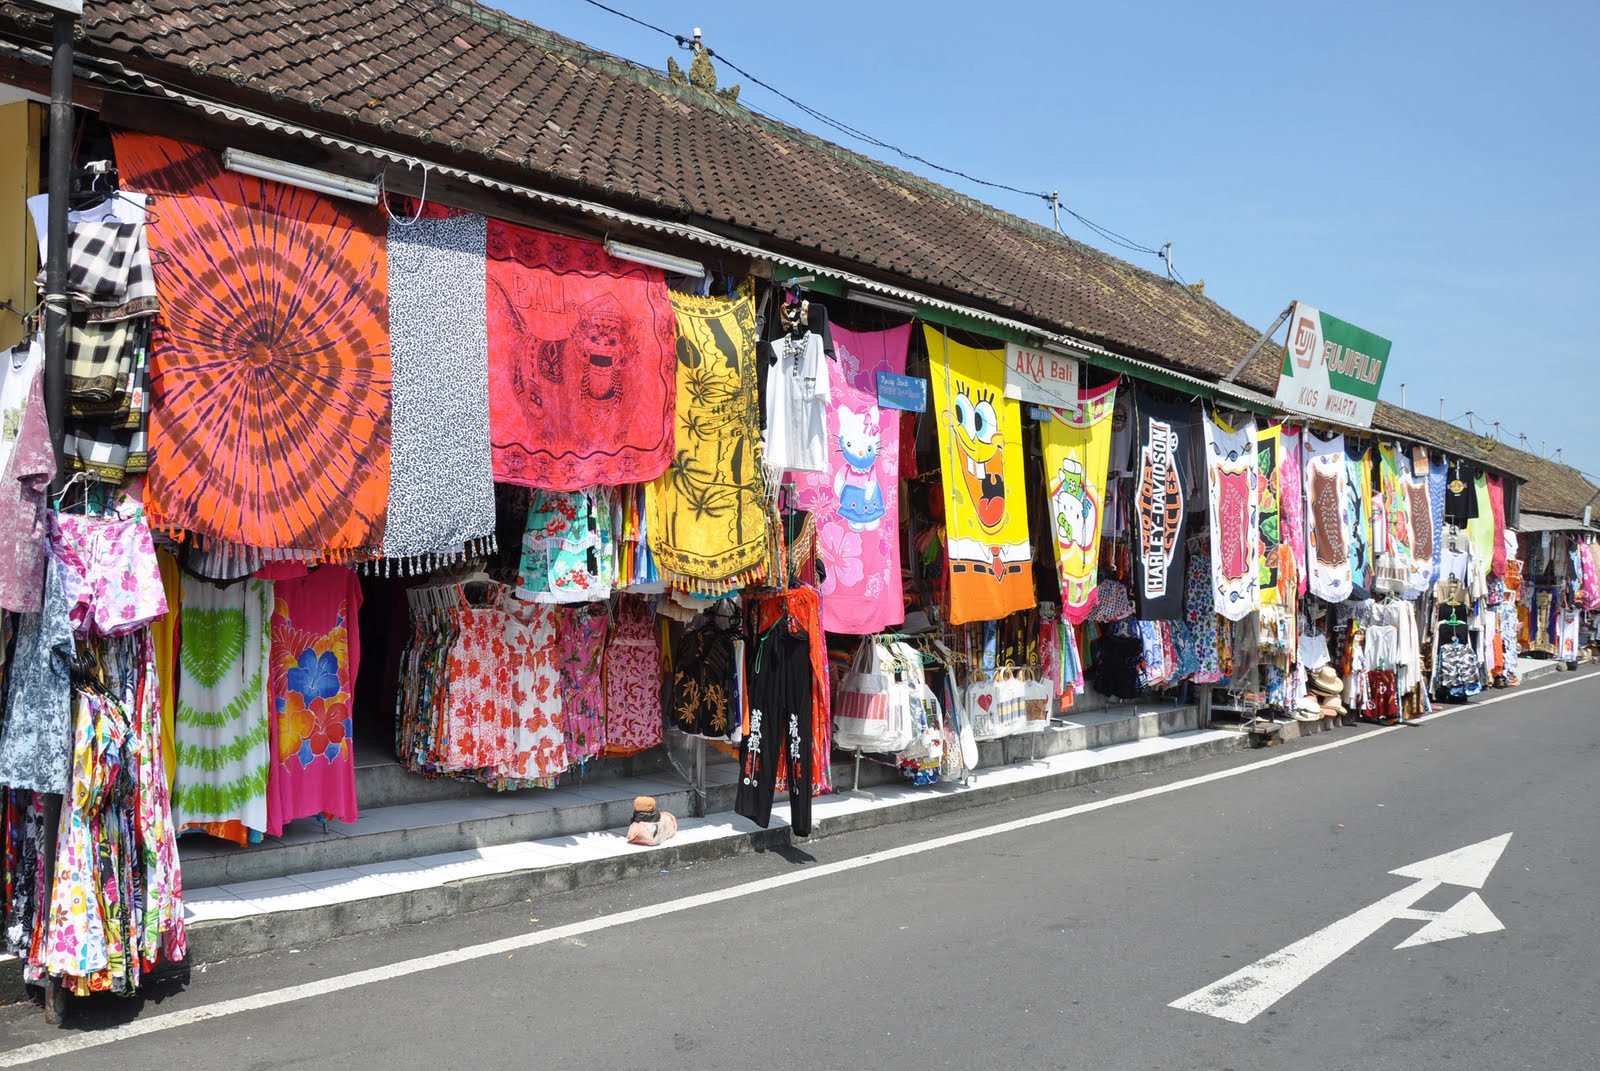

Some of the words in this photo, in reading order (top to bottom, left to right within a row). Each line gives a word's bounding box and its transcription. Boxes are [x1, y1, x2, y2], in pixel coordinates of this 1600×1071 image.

[512, 271, 566, 315] BALI
[1016, 351, 1045, 384] AKA
[1051, 360, 1073, 382] Bali
[1320, 340, 1382, 385] FUJIFILM
[1298, 387, 1319, 408] KIOS
[1325, 393, 1358, 418] WIHARTA
[1141, 465, 1152, 550] MOTOR
[1148, 429, 1168, 590] HARLEY-DAVIDSON
[1164, 470, 1181, 549] CYCLES
